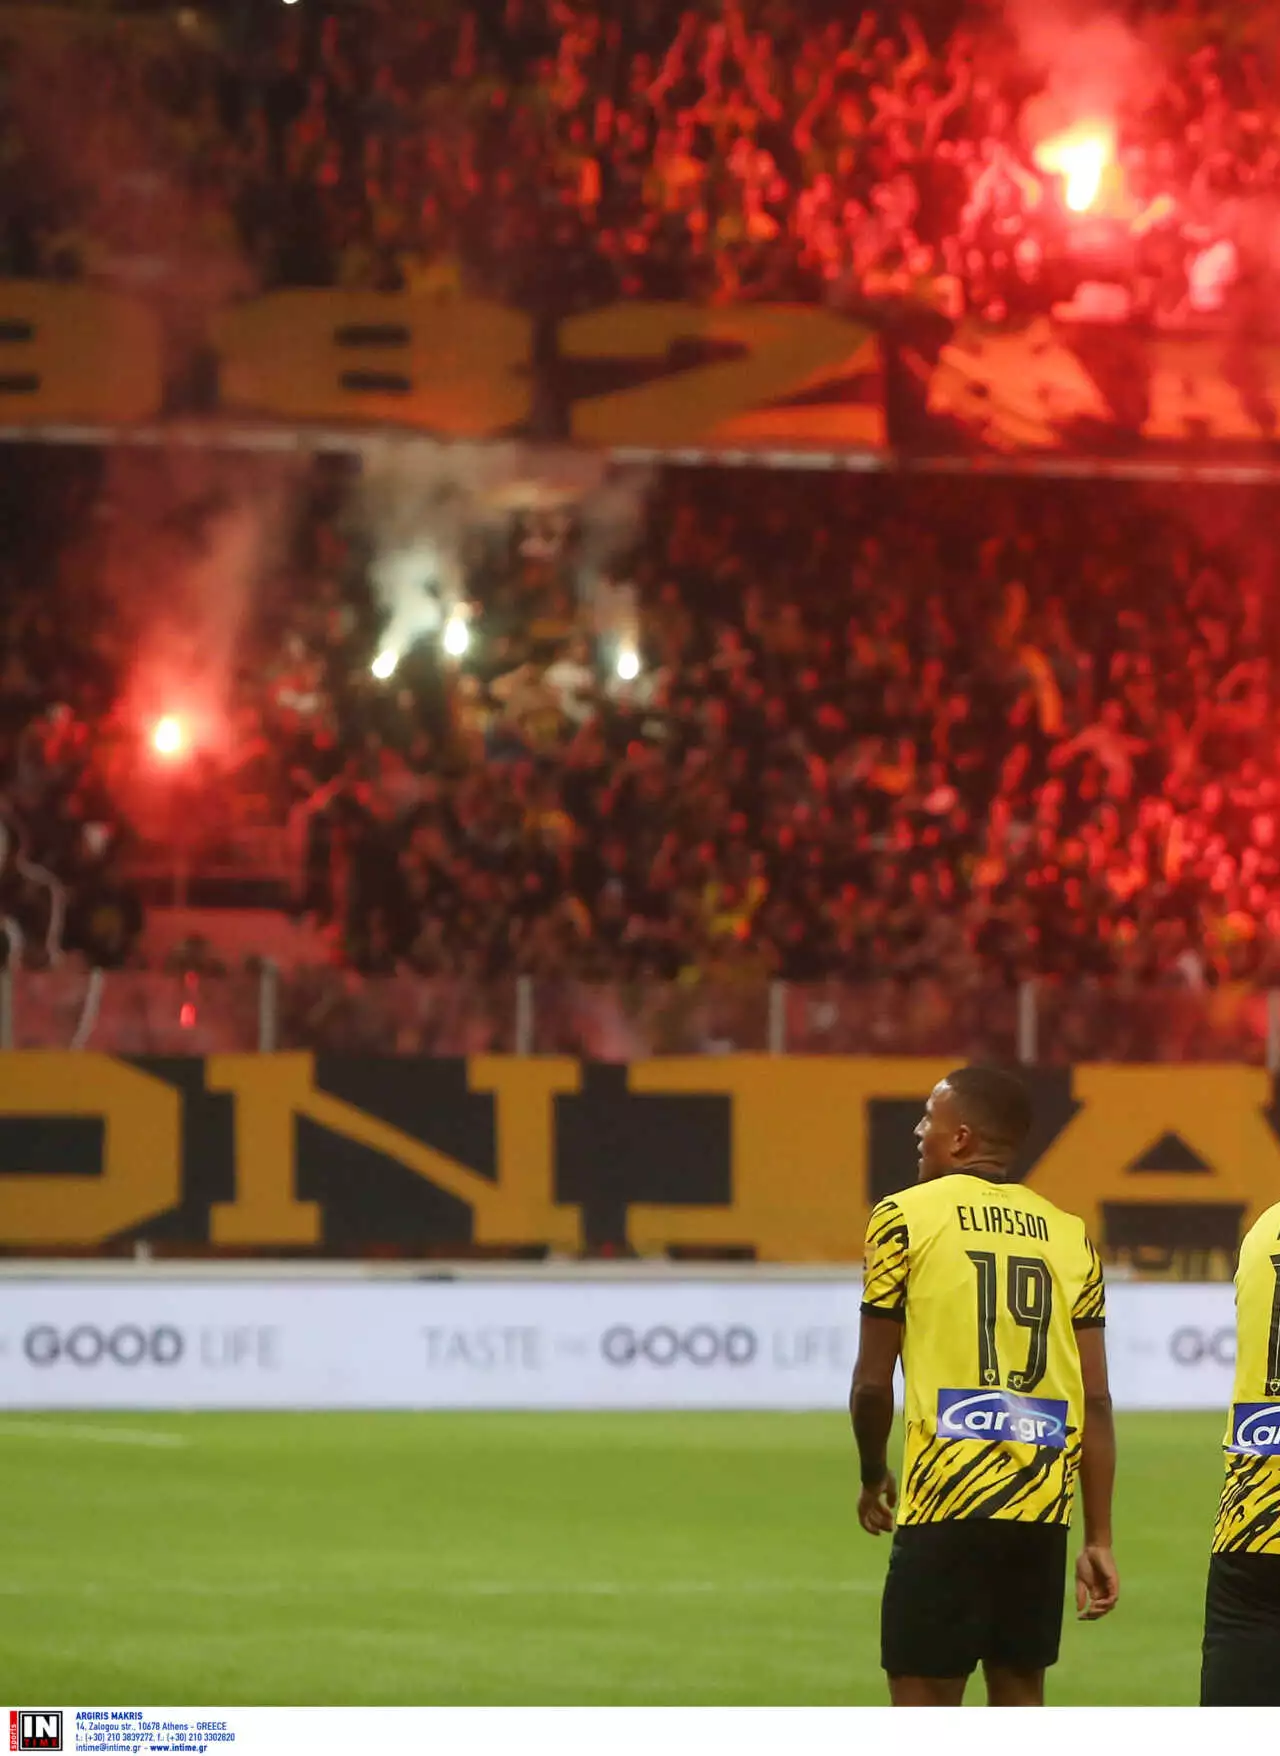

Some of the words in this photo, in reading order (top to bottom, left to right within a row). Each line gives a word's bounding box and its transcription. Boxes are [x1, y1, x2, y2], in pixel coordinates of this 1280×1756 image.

[957, 1205, 1049, 1242] ELIASSON
[965, 1250, 1052, 1393] 19
[24, 1322, 186, 1370] GOOD
[601, 1322, 757, 1369] GOOD
